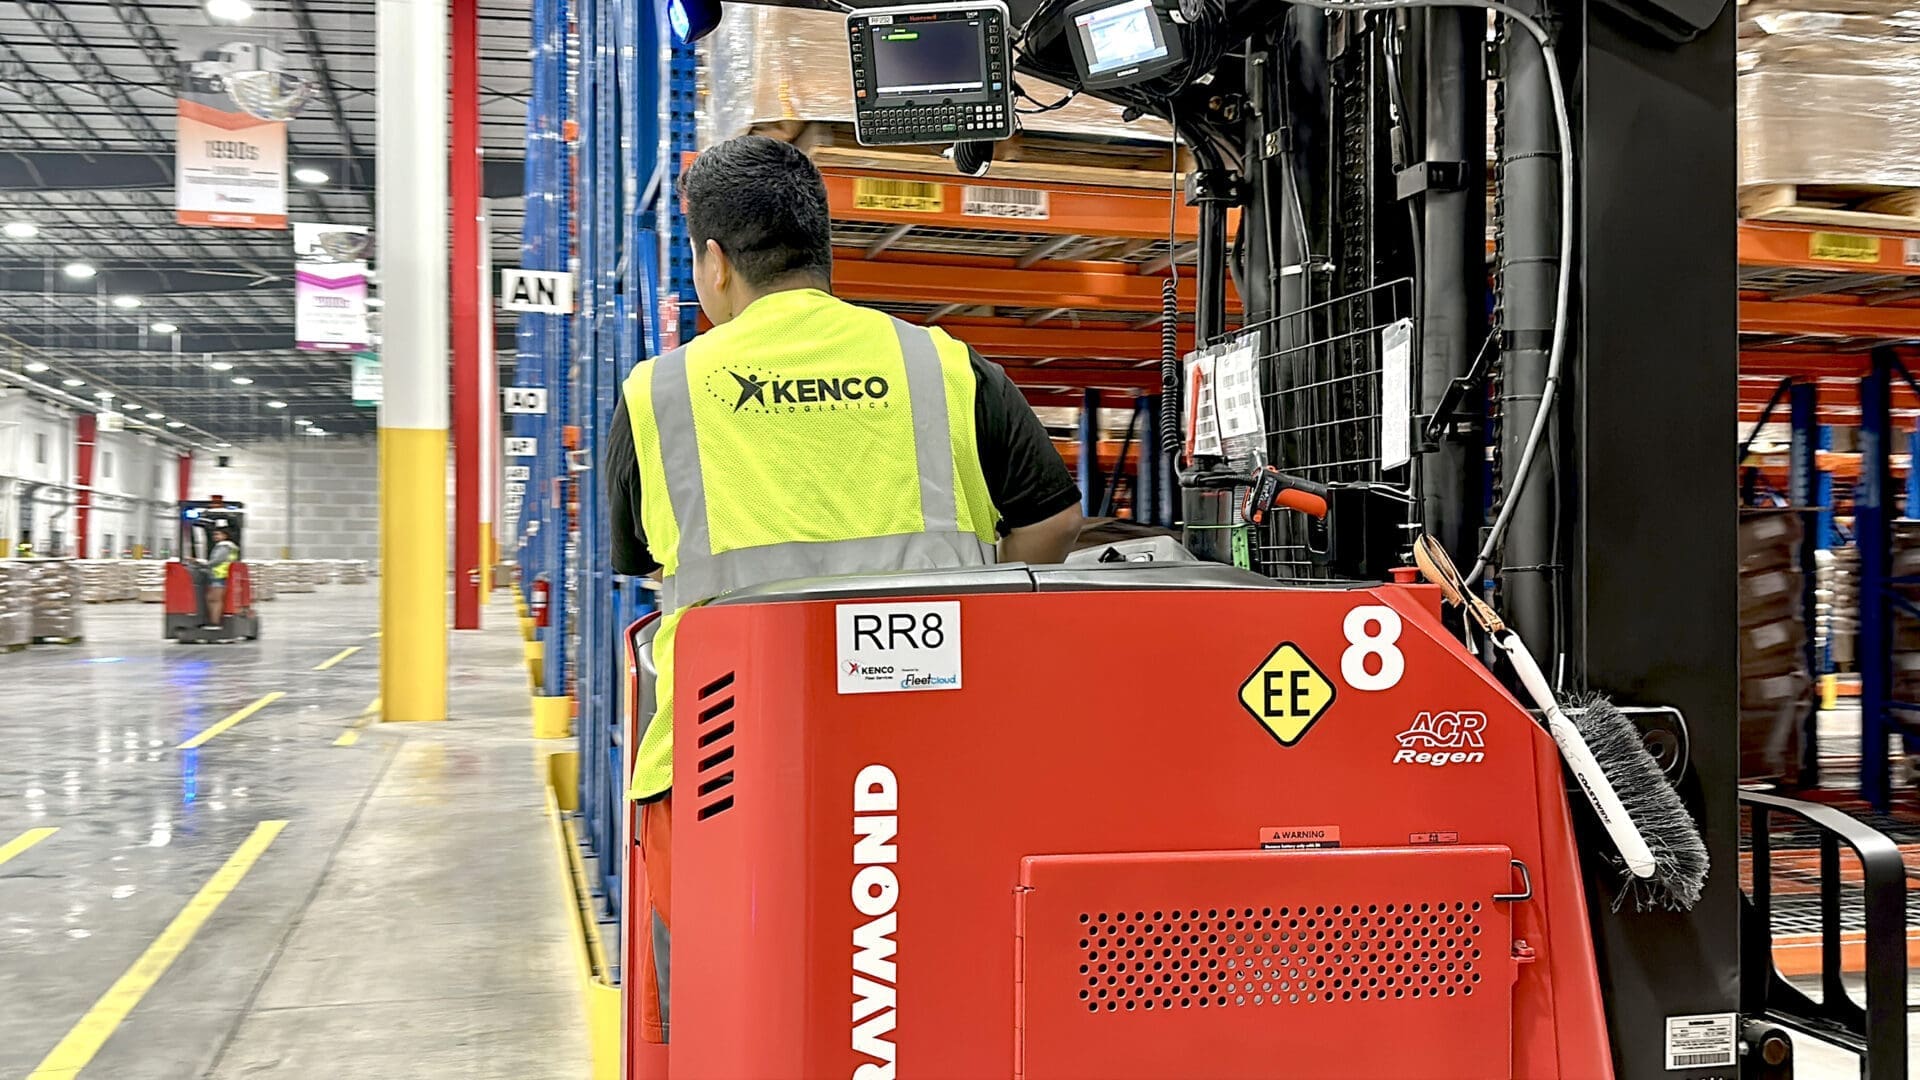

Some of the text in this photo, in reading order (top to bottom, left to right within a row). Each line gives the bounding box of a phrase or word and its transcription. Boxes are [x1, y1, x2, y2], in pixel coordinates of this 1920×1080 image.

[205, 140, 259, 160] 1990s
[511, 276, 557, 306] AN
[772, 376, 889, 404] KENCO
[774, 401, 889, 414] LOGISTICS
[853, 612, 944, 651] RR8
[1340, 605, 1405, 691] 8
[861, 666, 894, 675] KENCO
[1263, 671, 1311, 717] EE
[1395, 711, 1487, 748] ACR
[1393, 749, 1485, 767] Regen
[1282, 830, 1325, 839] WARNING
